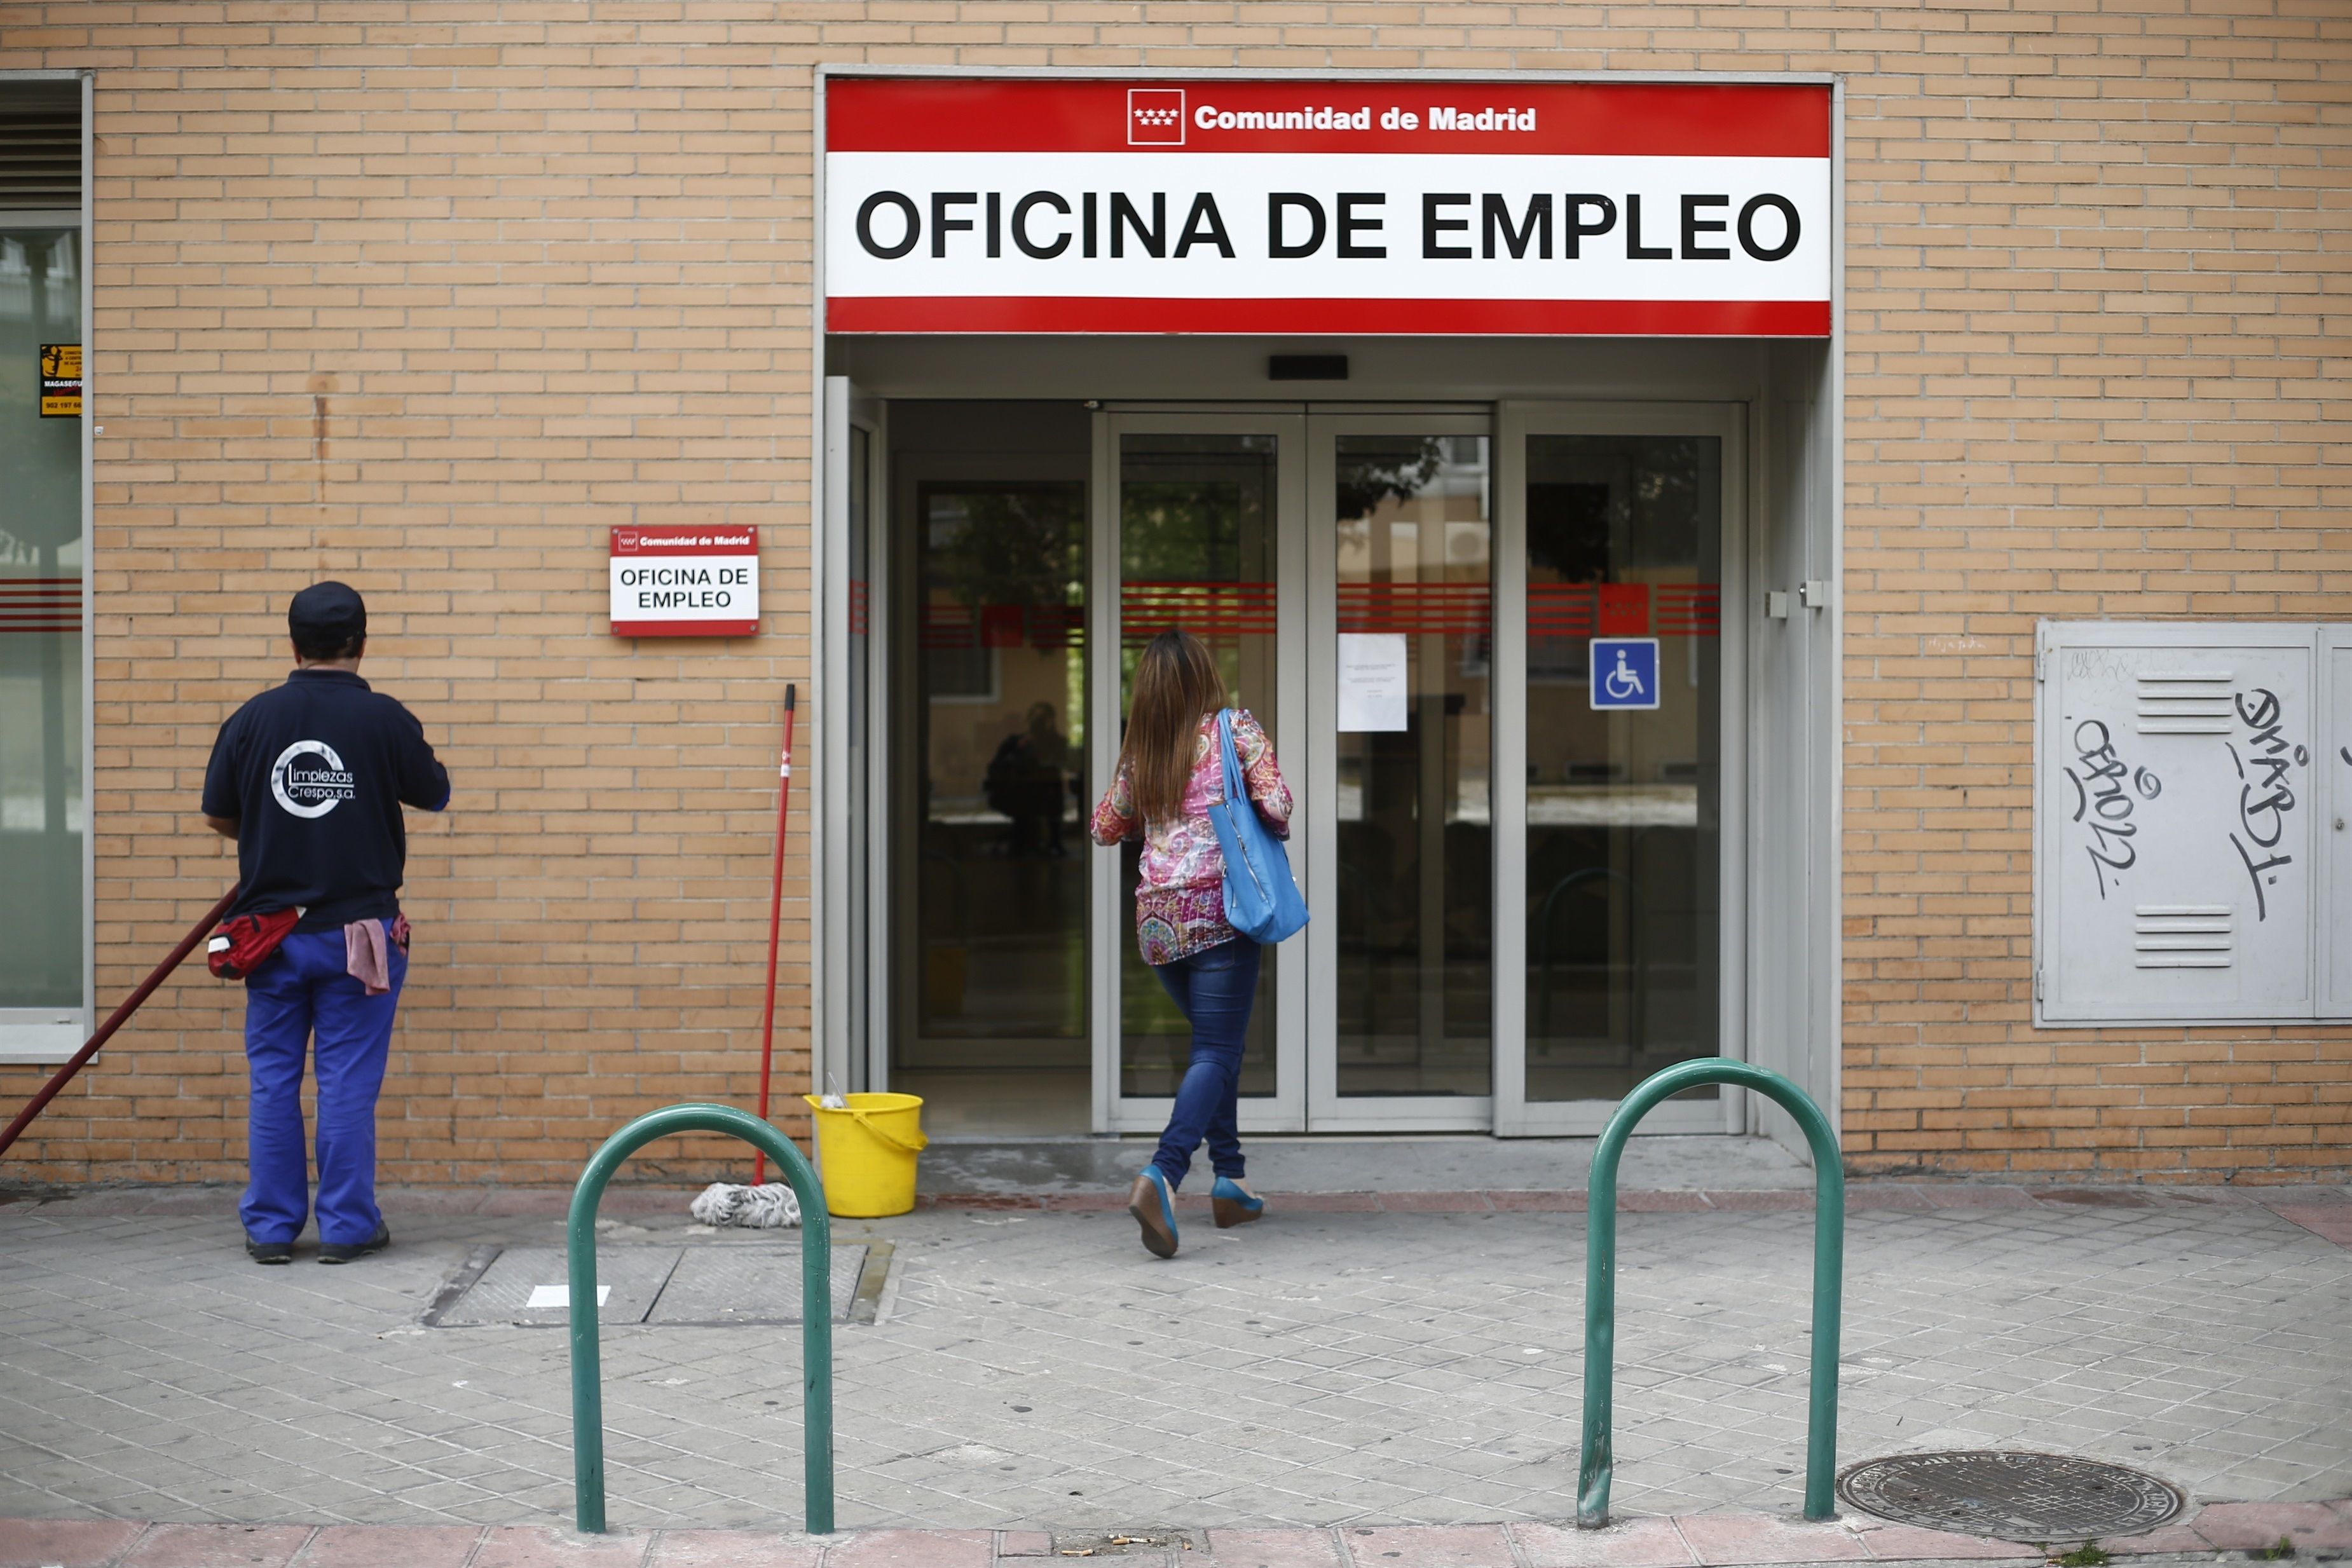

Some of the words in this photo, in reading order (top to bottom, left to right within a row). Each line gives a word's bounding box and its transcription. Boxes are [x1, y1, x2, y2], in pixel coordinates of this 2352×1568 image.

[1194, 105, 1371, 130] Comunidad
[1379, 106, 1419, 131] de
[1428, 107, 1536, 132] Madrid
[856, 190, 1236, 260] OFICINA
[1268, 192, 1388, 259] DE
[1422, 193, 1802, 262] EMPLEO
[639, 536, 697, 547] Comunidad
[698, 536, 712, 546] de
[714, 535, 751, 546] Madrid
[620, 569, 711, 586] OFICINA
[719, 568, 749, 585] DE
[638, 591, 732, 608] EMPLEO
